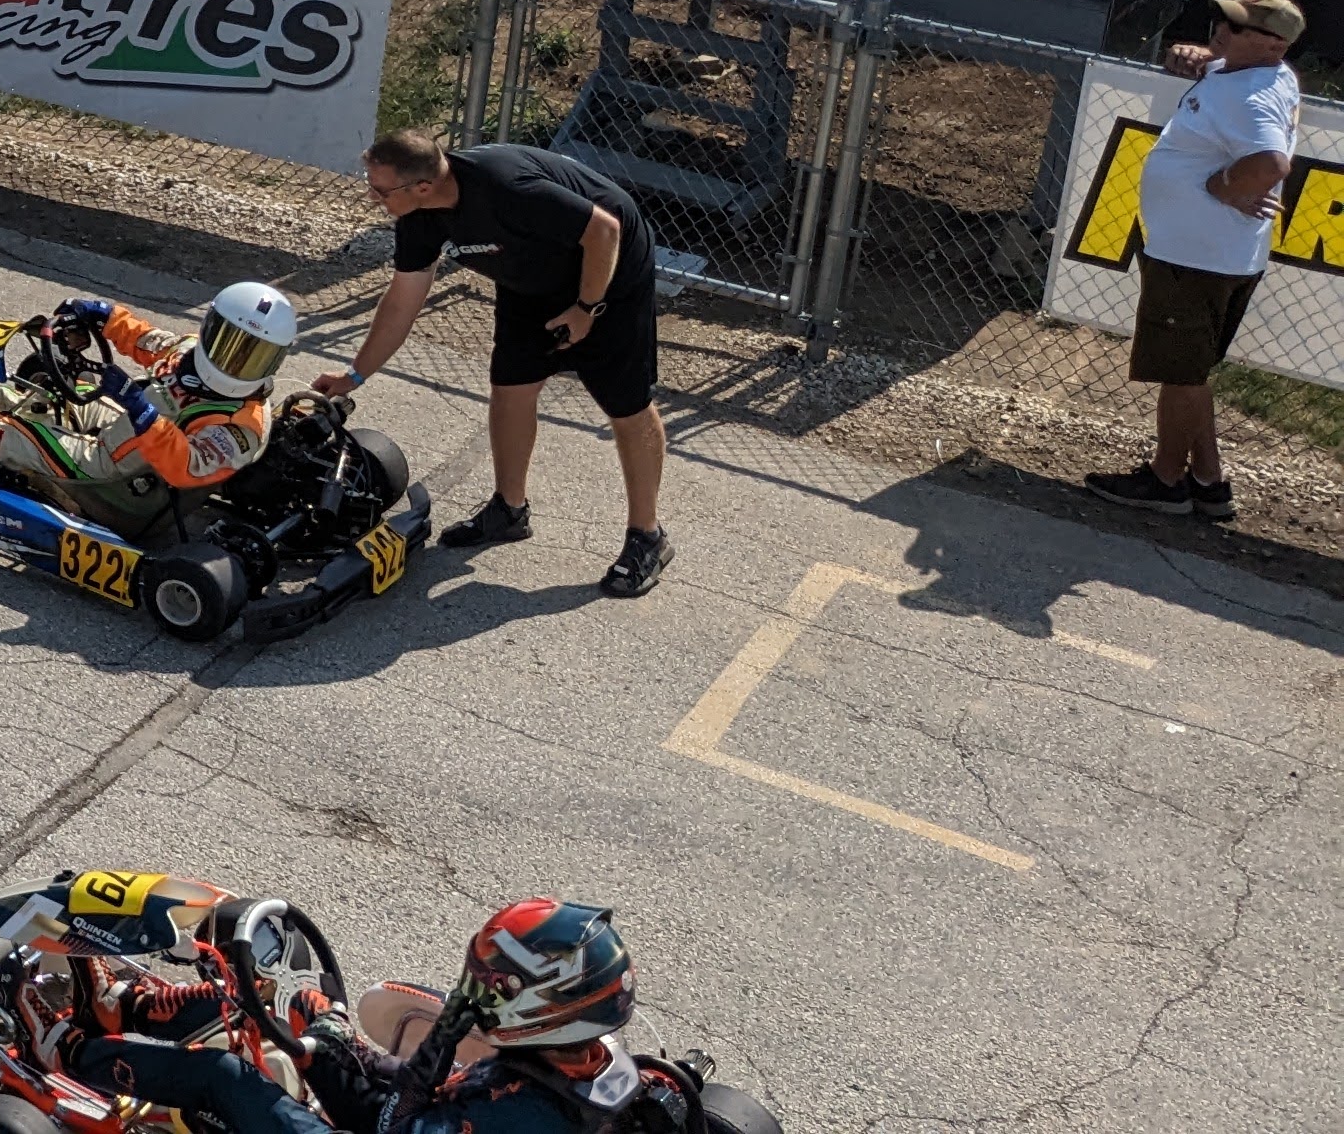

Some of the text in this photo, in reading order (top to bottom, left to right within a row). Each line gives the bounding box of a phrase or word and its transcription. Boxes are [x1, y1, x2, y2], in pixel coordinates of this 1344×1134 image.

[62, 532, 124, 599] 322
[364, 524, 405, 585] 322
[72, 916, 123, 946] QUINTEN
